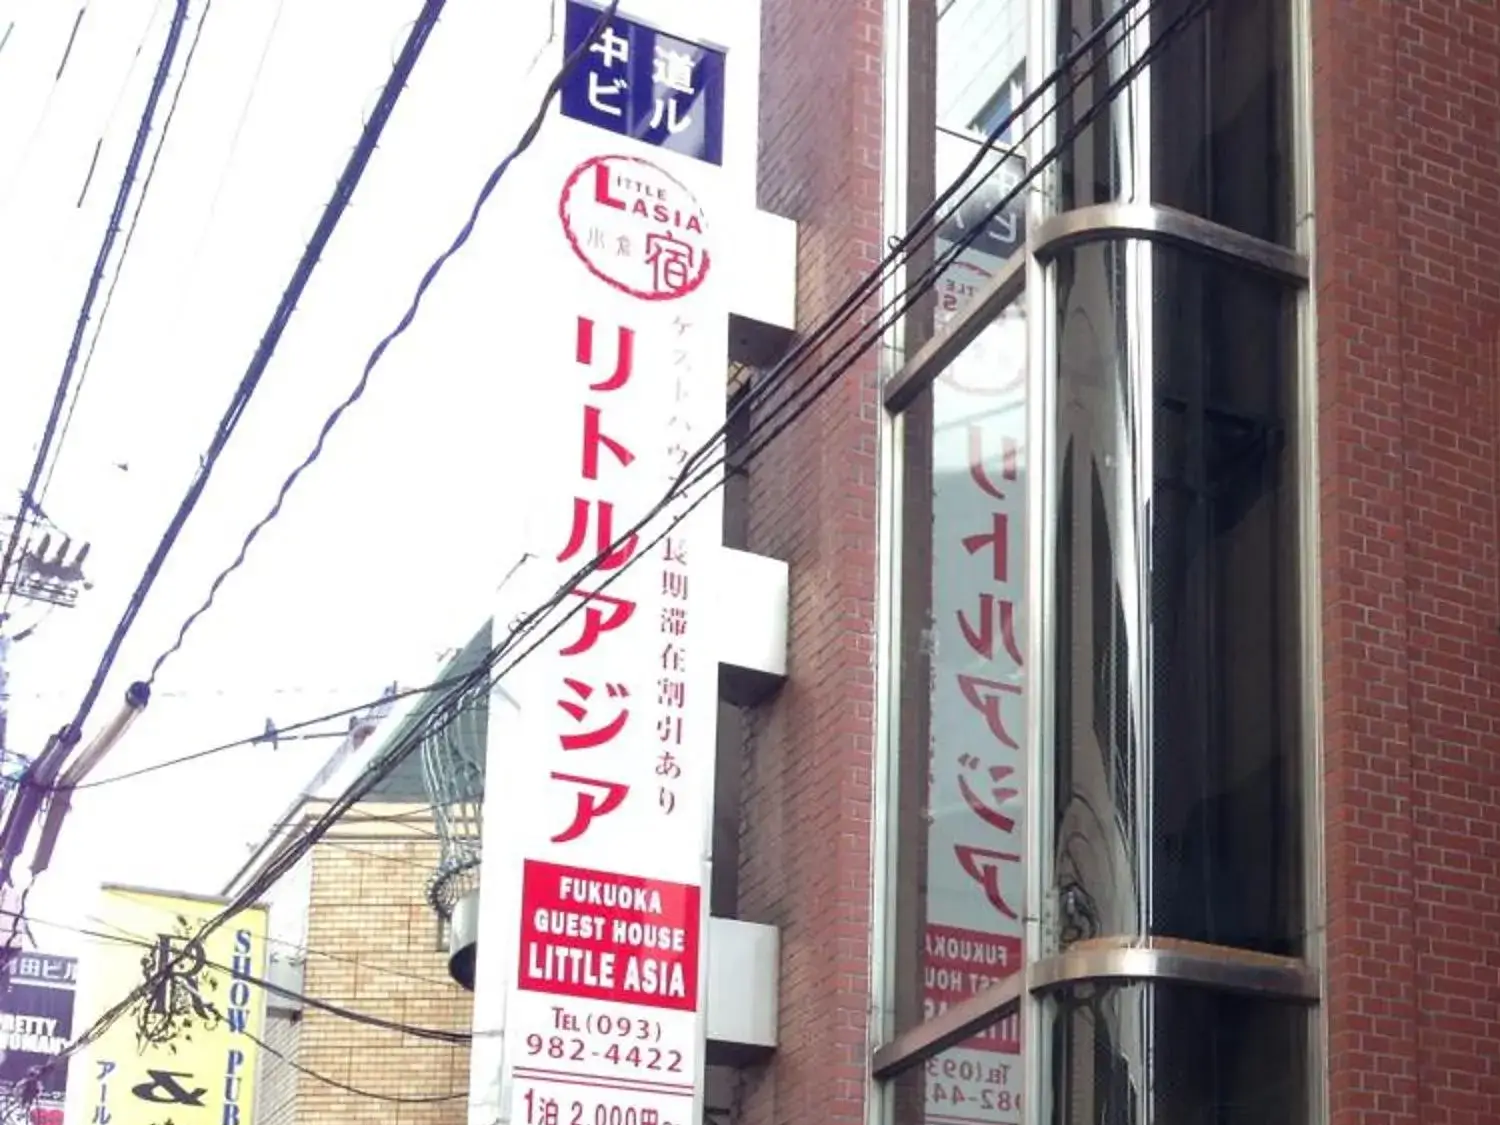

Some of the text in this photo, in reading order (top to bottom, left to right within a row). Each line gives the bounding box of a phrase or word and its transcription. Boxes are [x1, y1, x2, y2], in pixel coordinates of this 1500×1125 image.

[596, 162, 668, 210] LITTLE
[631, 197, 703, 234] ASIA
[644, 229, 694, 292] 宿
[551, 314, 638, 843] リトルアジア
[559, 875, 663, 915] FUKUOKA
[533, 907, 686, 953] GUEST HOUSE
[227, 929, 253, 1034] SHOW
[527, 941, 686, 998] LITTLE ASIA
[526, 1033, 683, 1073] 982-4422
